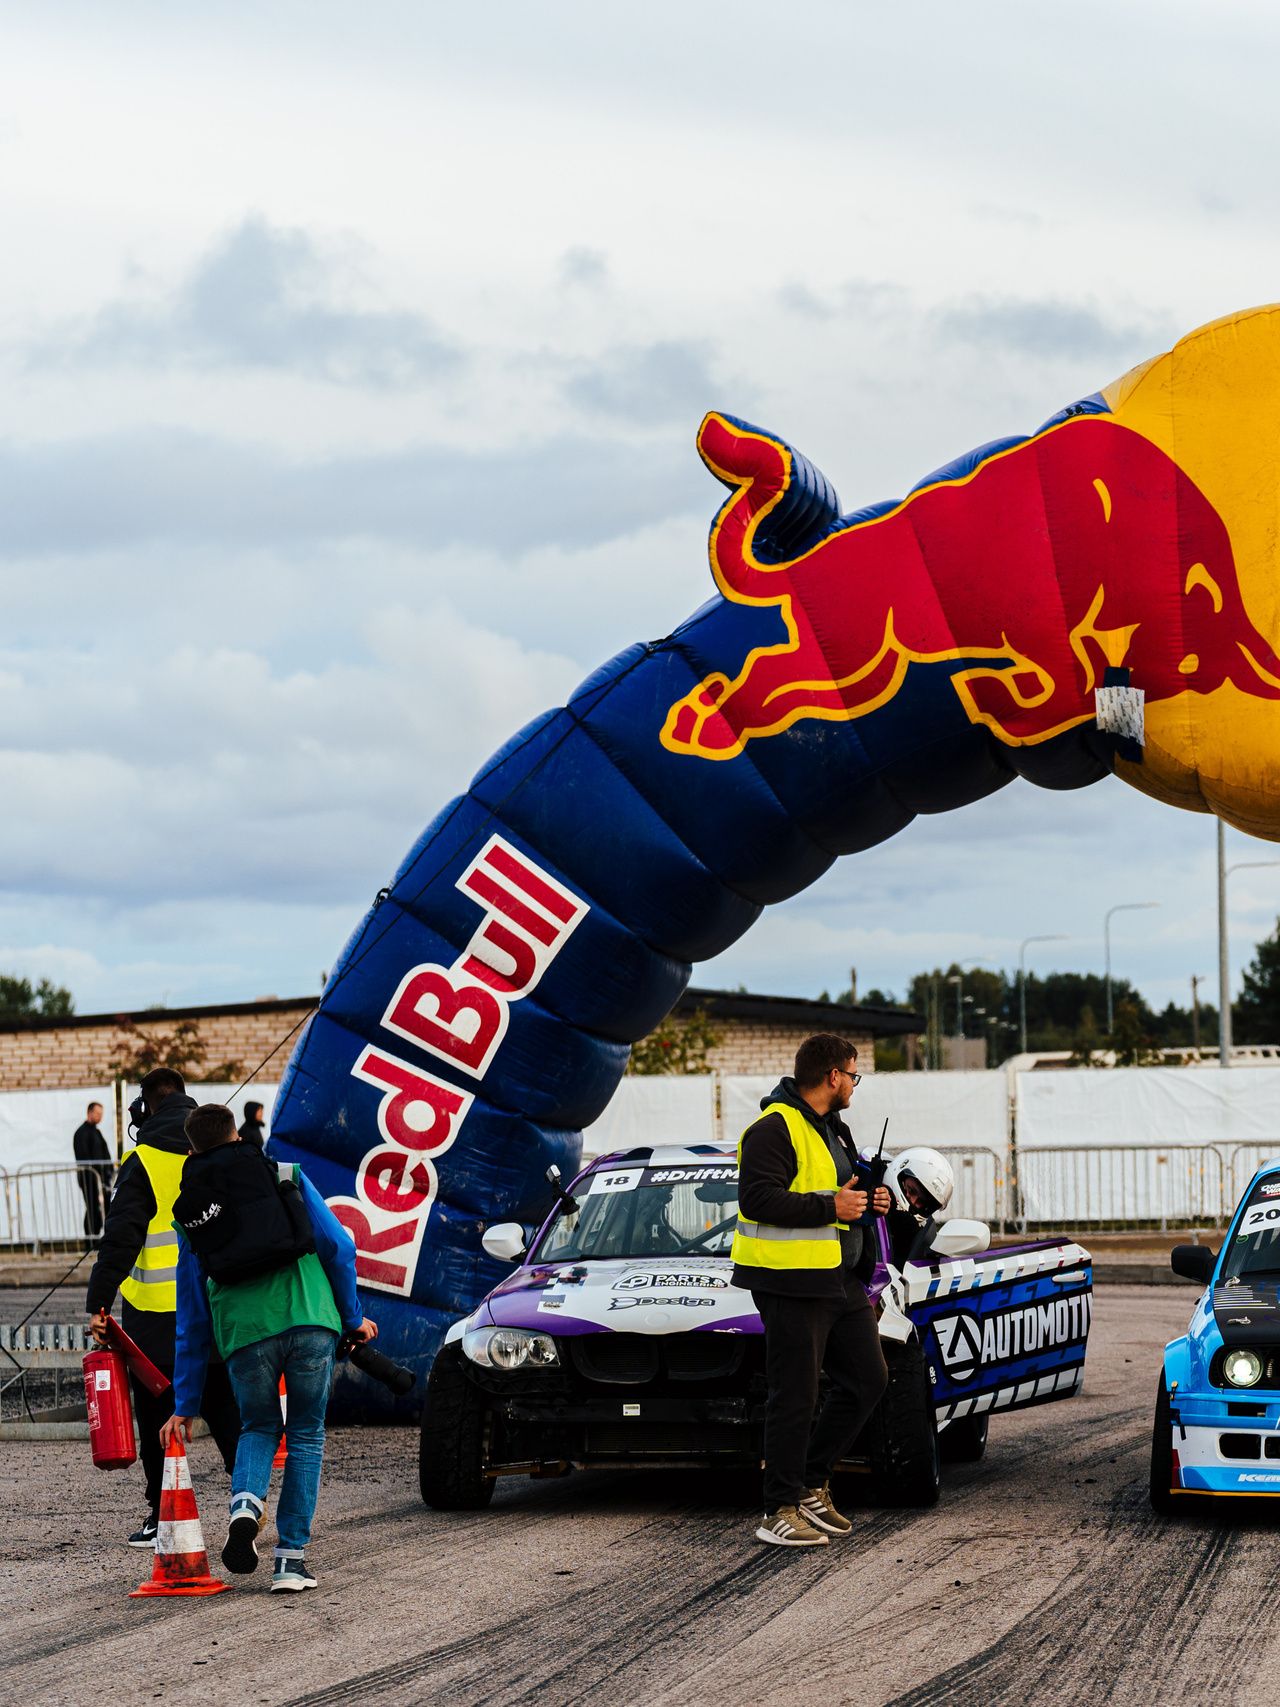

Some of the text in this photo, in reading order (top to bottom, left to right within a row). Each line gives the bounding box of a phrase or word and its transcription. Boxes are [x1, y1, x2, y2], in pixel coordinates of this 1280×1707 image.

[328, 839, 584, 1292] Red Bull
[604, 1176, 630, 1186] 18
[650, 1168, 739, 1182] #DriftM
[655, 1275, 710, 1284] PARTS
